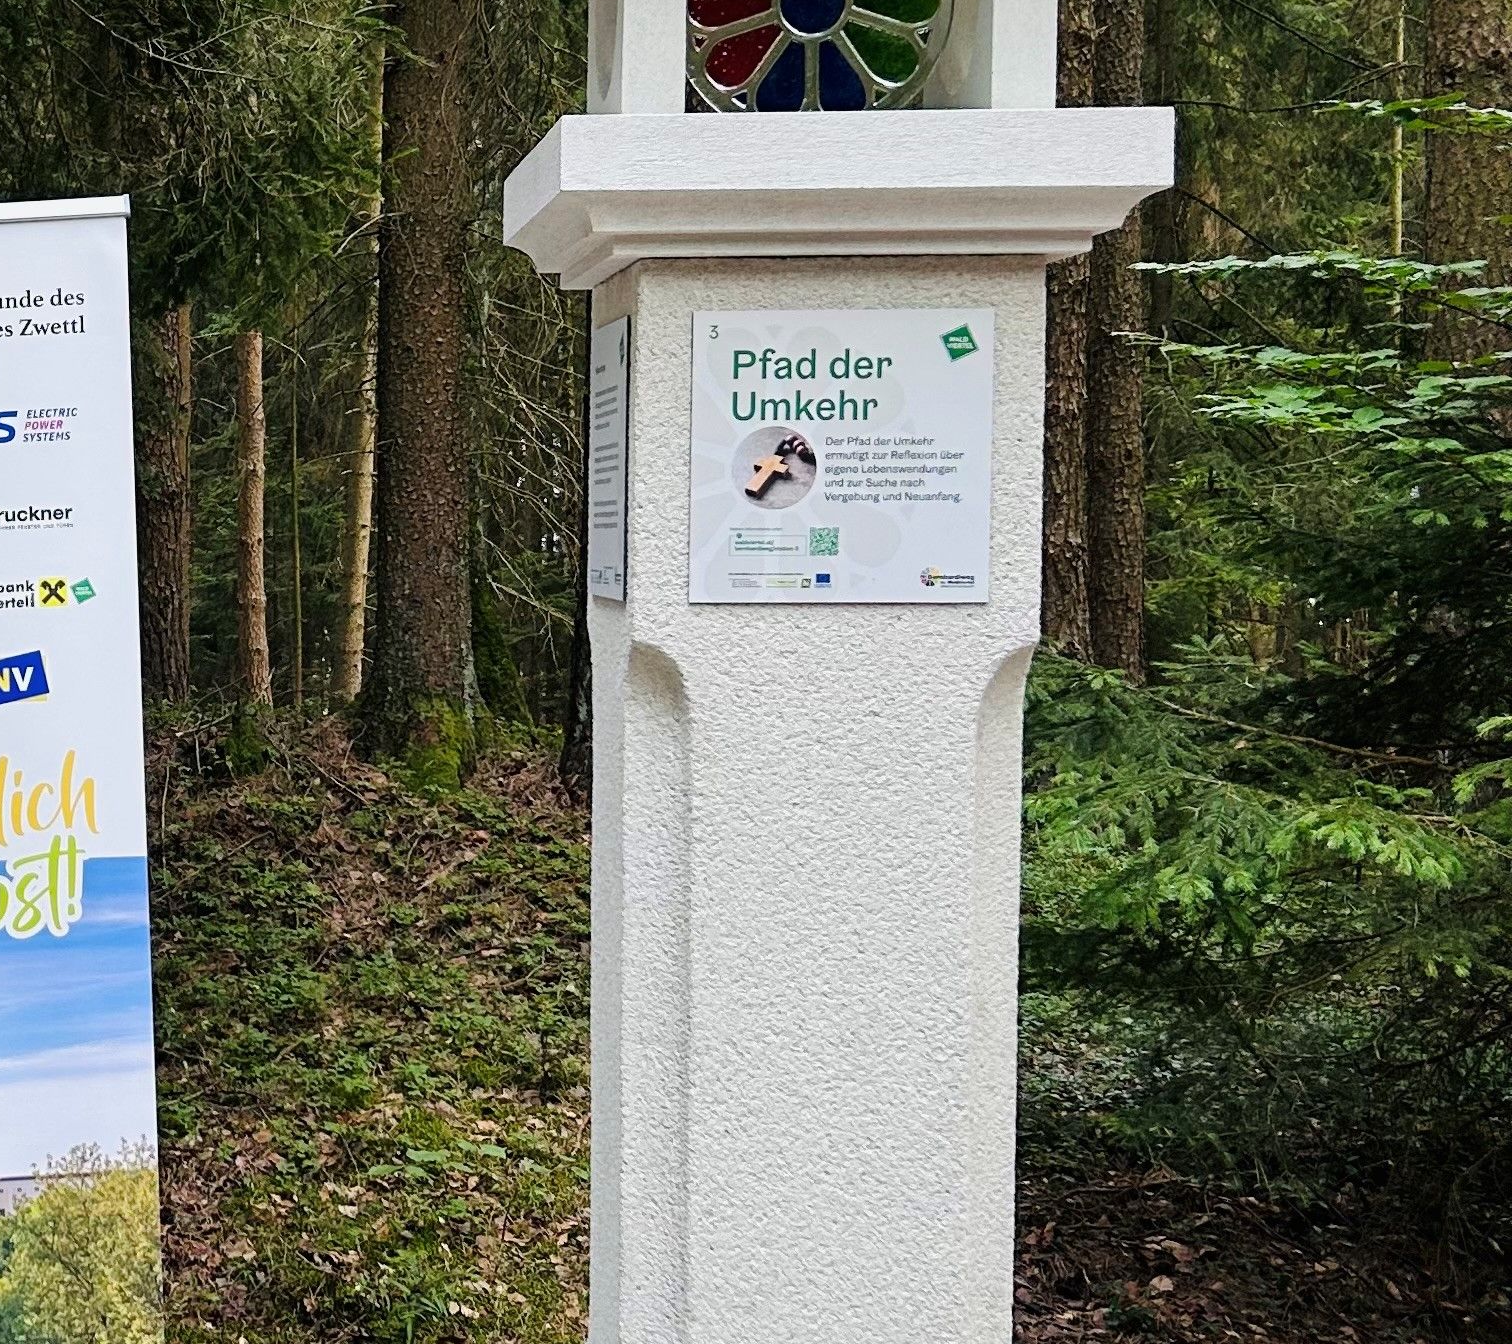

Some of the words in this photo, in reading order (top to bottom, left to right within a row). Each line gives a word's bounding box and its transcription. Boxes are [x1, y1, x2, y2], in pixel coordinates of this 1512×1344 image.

[50, 288, 85, 306] des
[19, 315, 85, 336] Zwettl
[708, 325, 719, 339] 3
[733, 348, 817, 379] Pfad
[829, 348, 892, 379] der
[732, 389, 878, 421] Umkehr
[26, 407, 78, 419] ELECTRIC
[24, 419, 63, 431] POWER
[22, 431, 71, 442] SYSTEMS
[825, 437, 844, 446] Der
[847, 437, 871, 446] Pfad
[874, 437, 893, 446] der
[894, 436, 934, 446] Umkehr
[825, 478, 843, 487] und
[866, 478, 897, 487] Suche
[900, 478, 925, 487] nach
[824, 492, 880, 503] Vergebung
[883, 492, 901, 501] und
